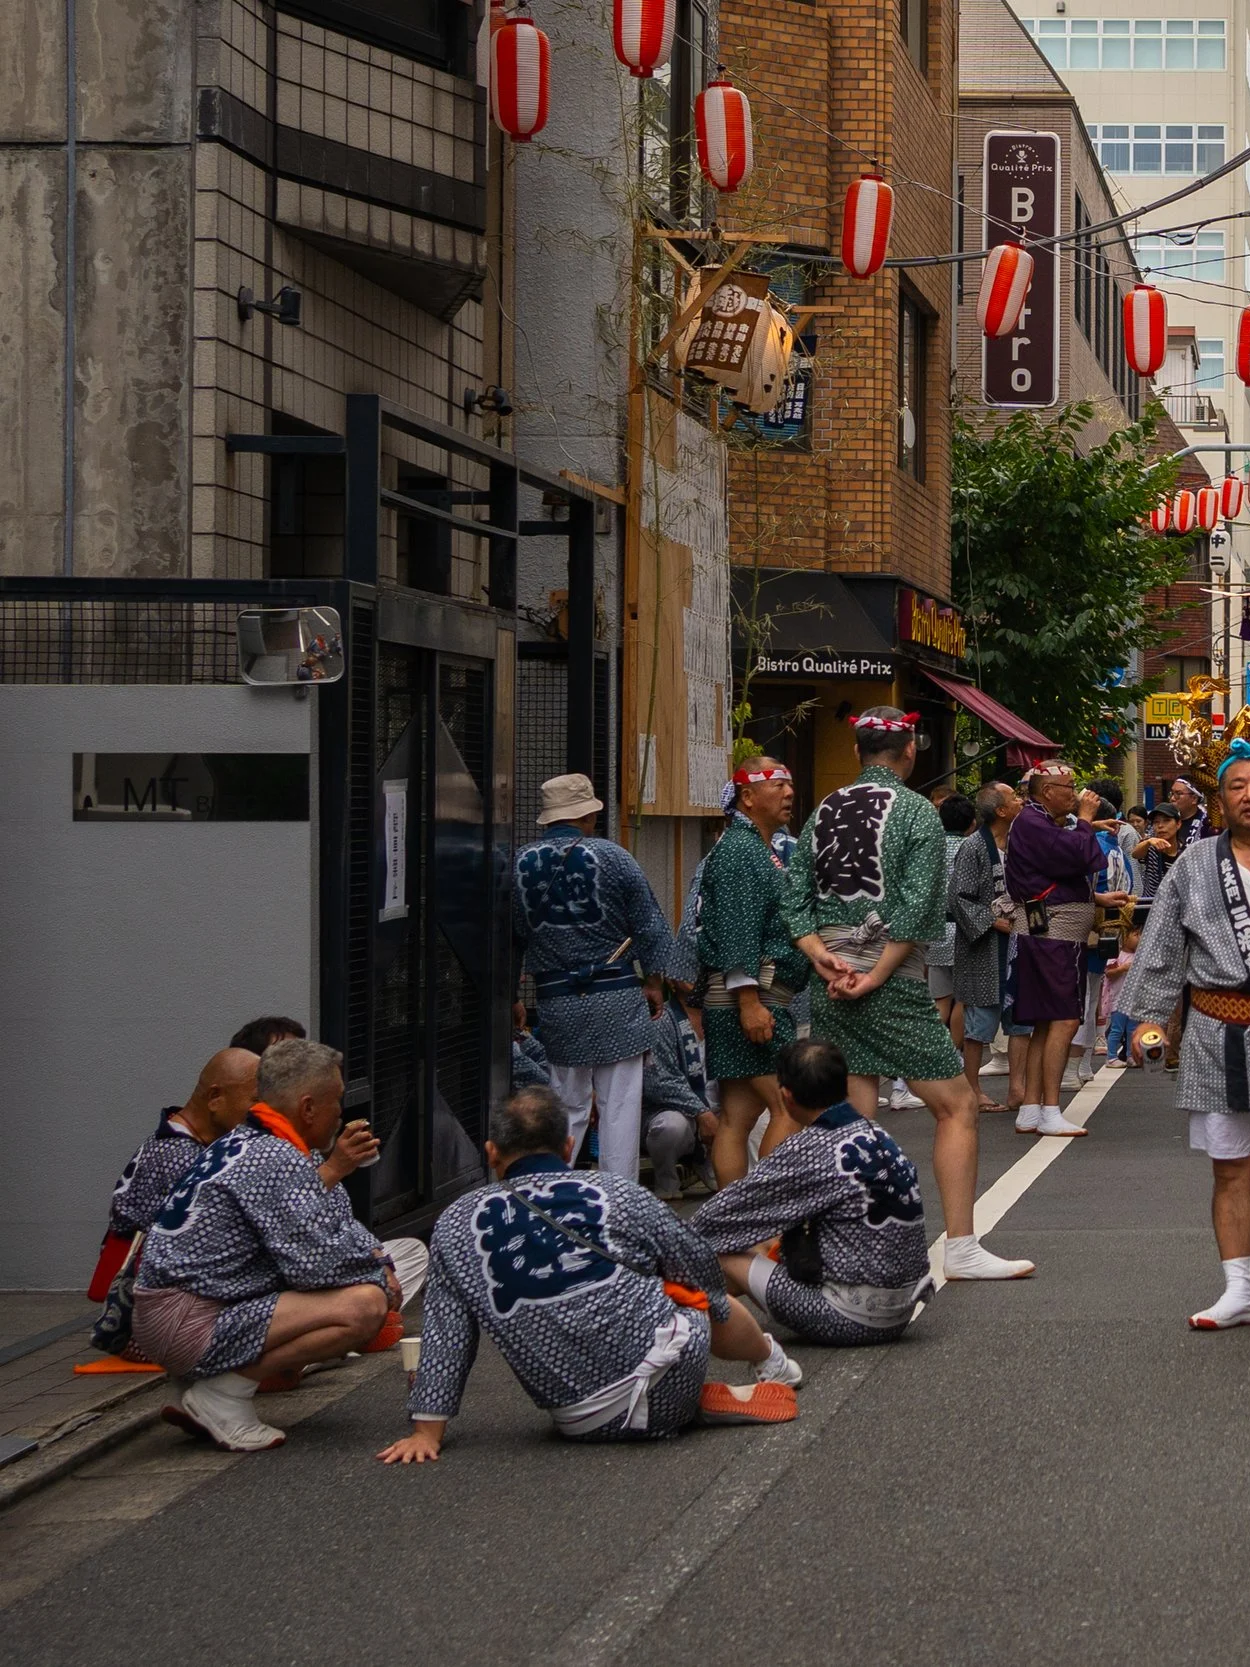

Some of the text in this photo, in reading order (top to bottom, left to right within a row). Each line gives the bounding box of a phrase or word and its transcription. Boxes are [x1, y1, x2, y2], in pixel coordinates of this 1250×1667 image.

[991, 162, 1053, 172] Qualité Prix
[1011, 187, 1035, 392] Btro
[1211, 533, 1226, 567] 中二
[757, 656, 892, 675] Bistro Qualité Prix
[1150, 726, 1167, 737] IN
[124, 777, 189, 811] MT
